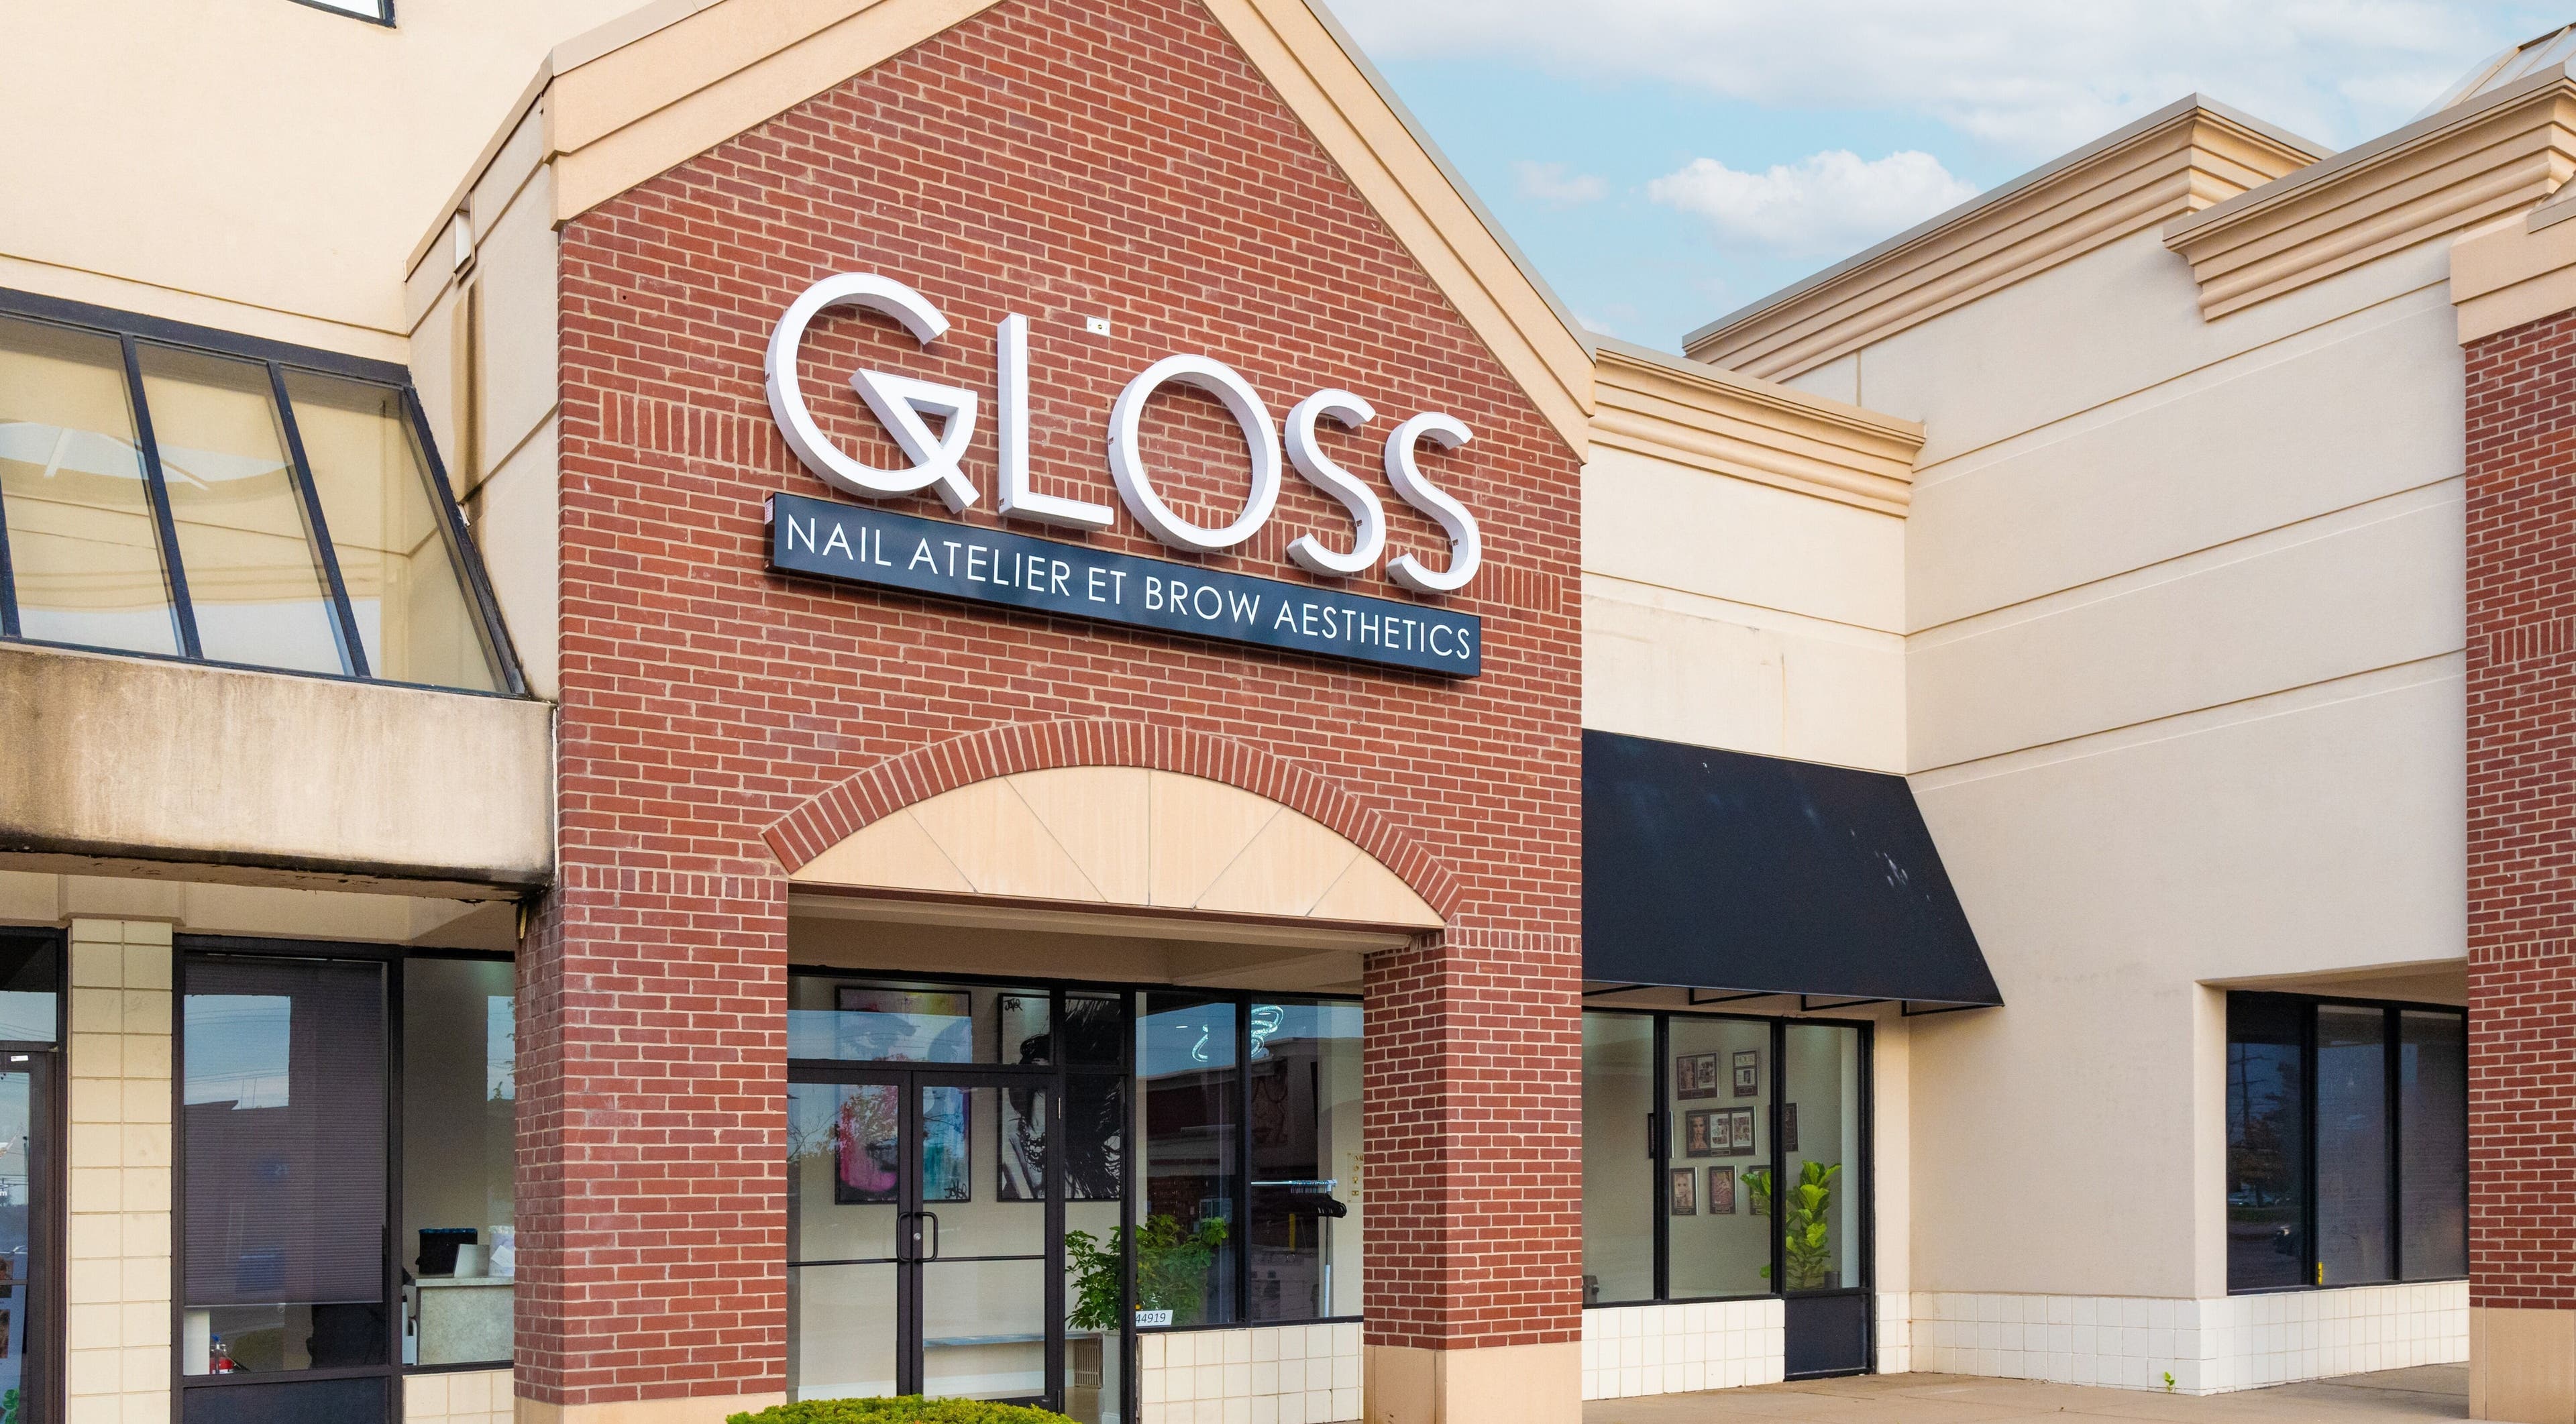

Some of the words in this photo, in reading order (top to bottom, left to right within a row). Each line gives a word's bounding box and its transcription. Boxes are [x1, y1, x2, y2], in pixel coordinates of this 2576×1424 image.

[765, 271, 1483, 594] GLOSS
[788, 514, 892, 567] NAIL
[908, 537, 1071, 597] ATELIER
[1087, 566, 1127, 604] ET
[1145, 576, 1261, 625] BROW
[1274, 599, 1470, 660] AESTHETICS
[1136, 1313, 1166, 1323] 44919
